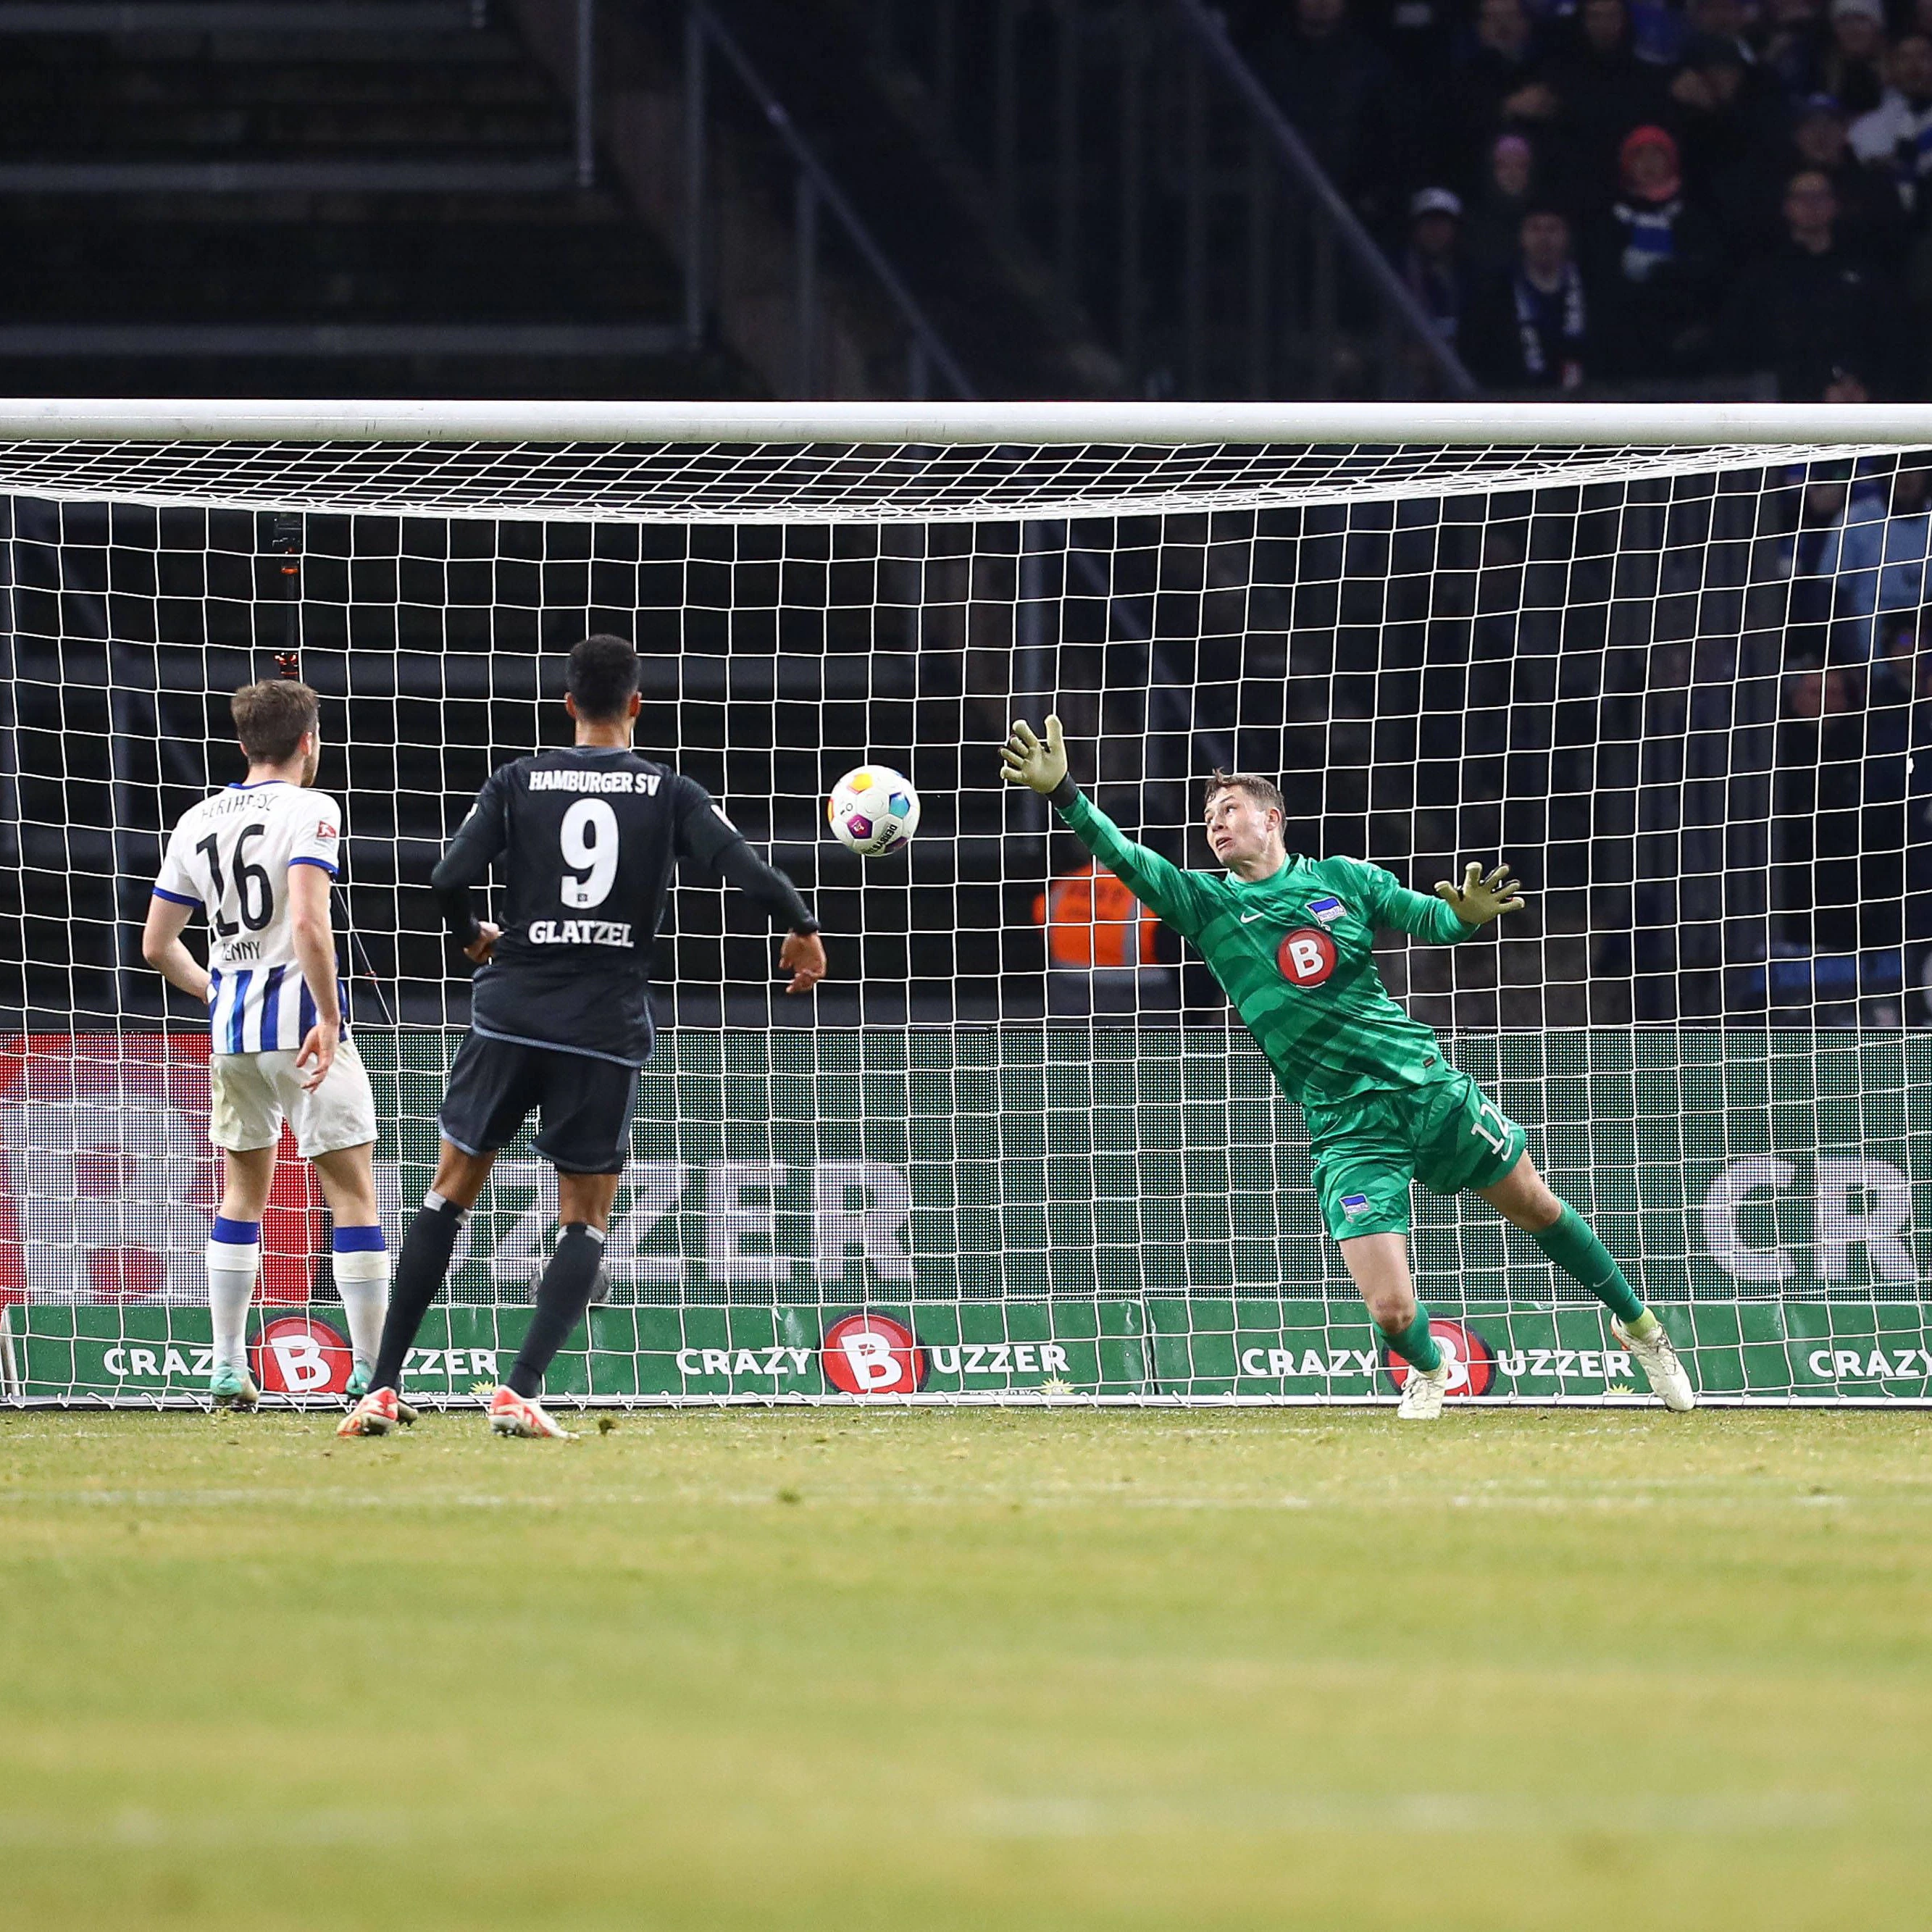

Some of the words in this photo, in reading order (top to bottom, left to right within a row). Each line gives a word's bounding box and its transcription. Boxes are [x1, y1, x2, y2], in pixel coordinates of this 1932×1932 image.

[529, 770, 633, 793] HAMBURGER
[634, 773, 661, 796] SV
[560, 798, 619, 908] 9
[196, 824, 273, 937] 16
[528, 920, 634, 948] GLATZEL
[222, 941, 260, 961] ENNY
[1289, 939, 1324, 978] B
[1701, 1156, 1932, 1281] CR
[103, 1348, 214, 1376] CRAZ
[399, 1348, 500, 1375] ZZER
[676, 1347, 812, 1375] CRAZY
[932, 1345, 1071, 1373] UZZER
[1241, 1347, 1378, 1376] CRAZY
[1497, 1350, 1635, 1377] UZZER
[1808, 1350, 1932, 1377] CRAZY
